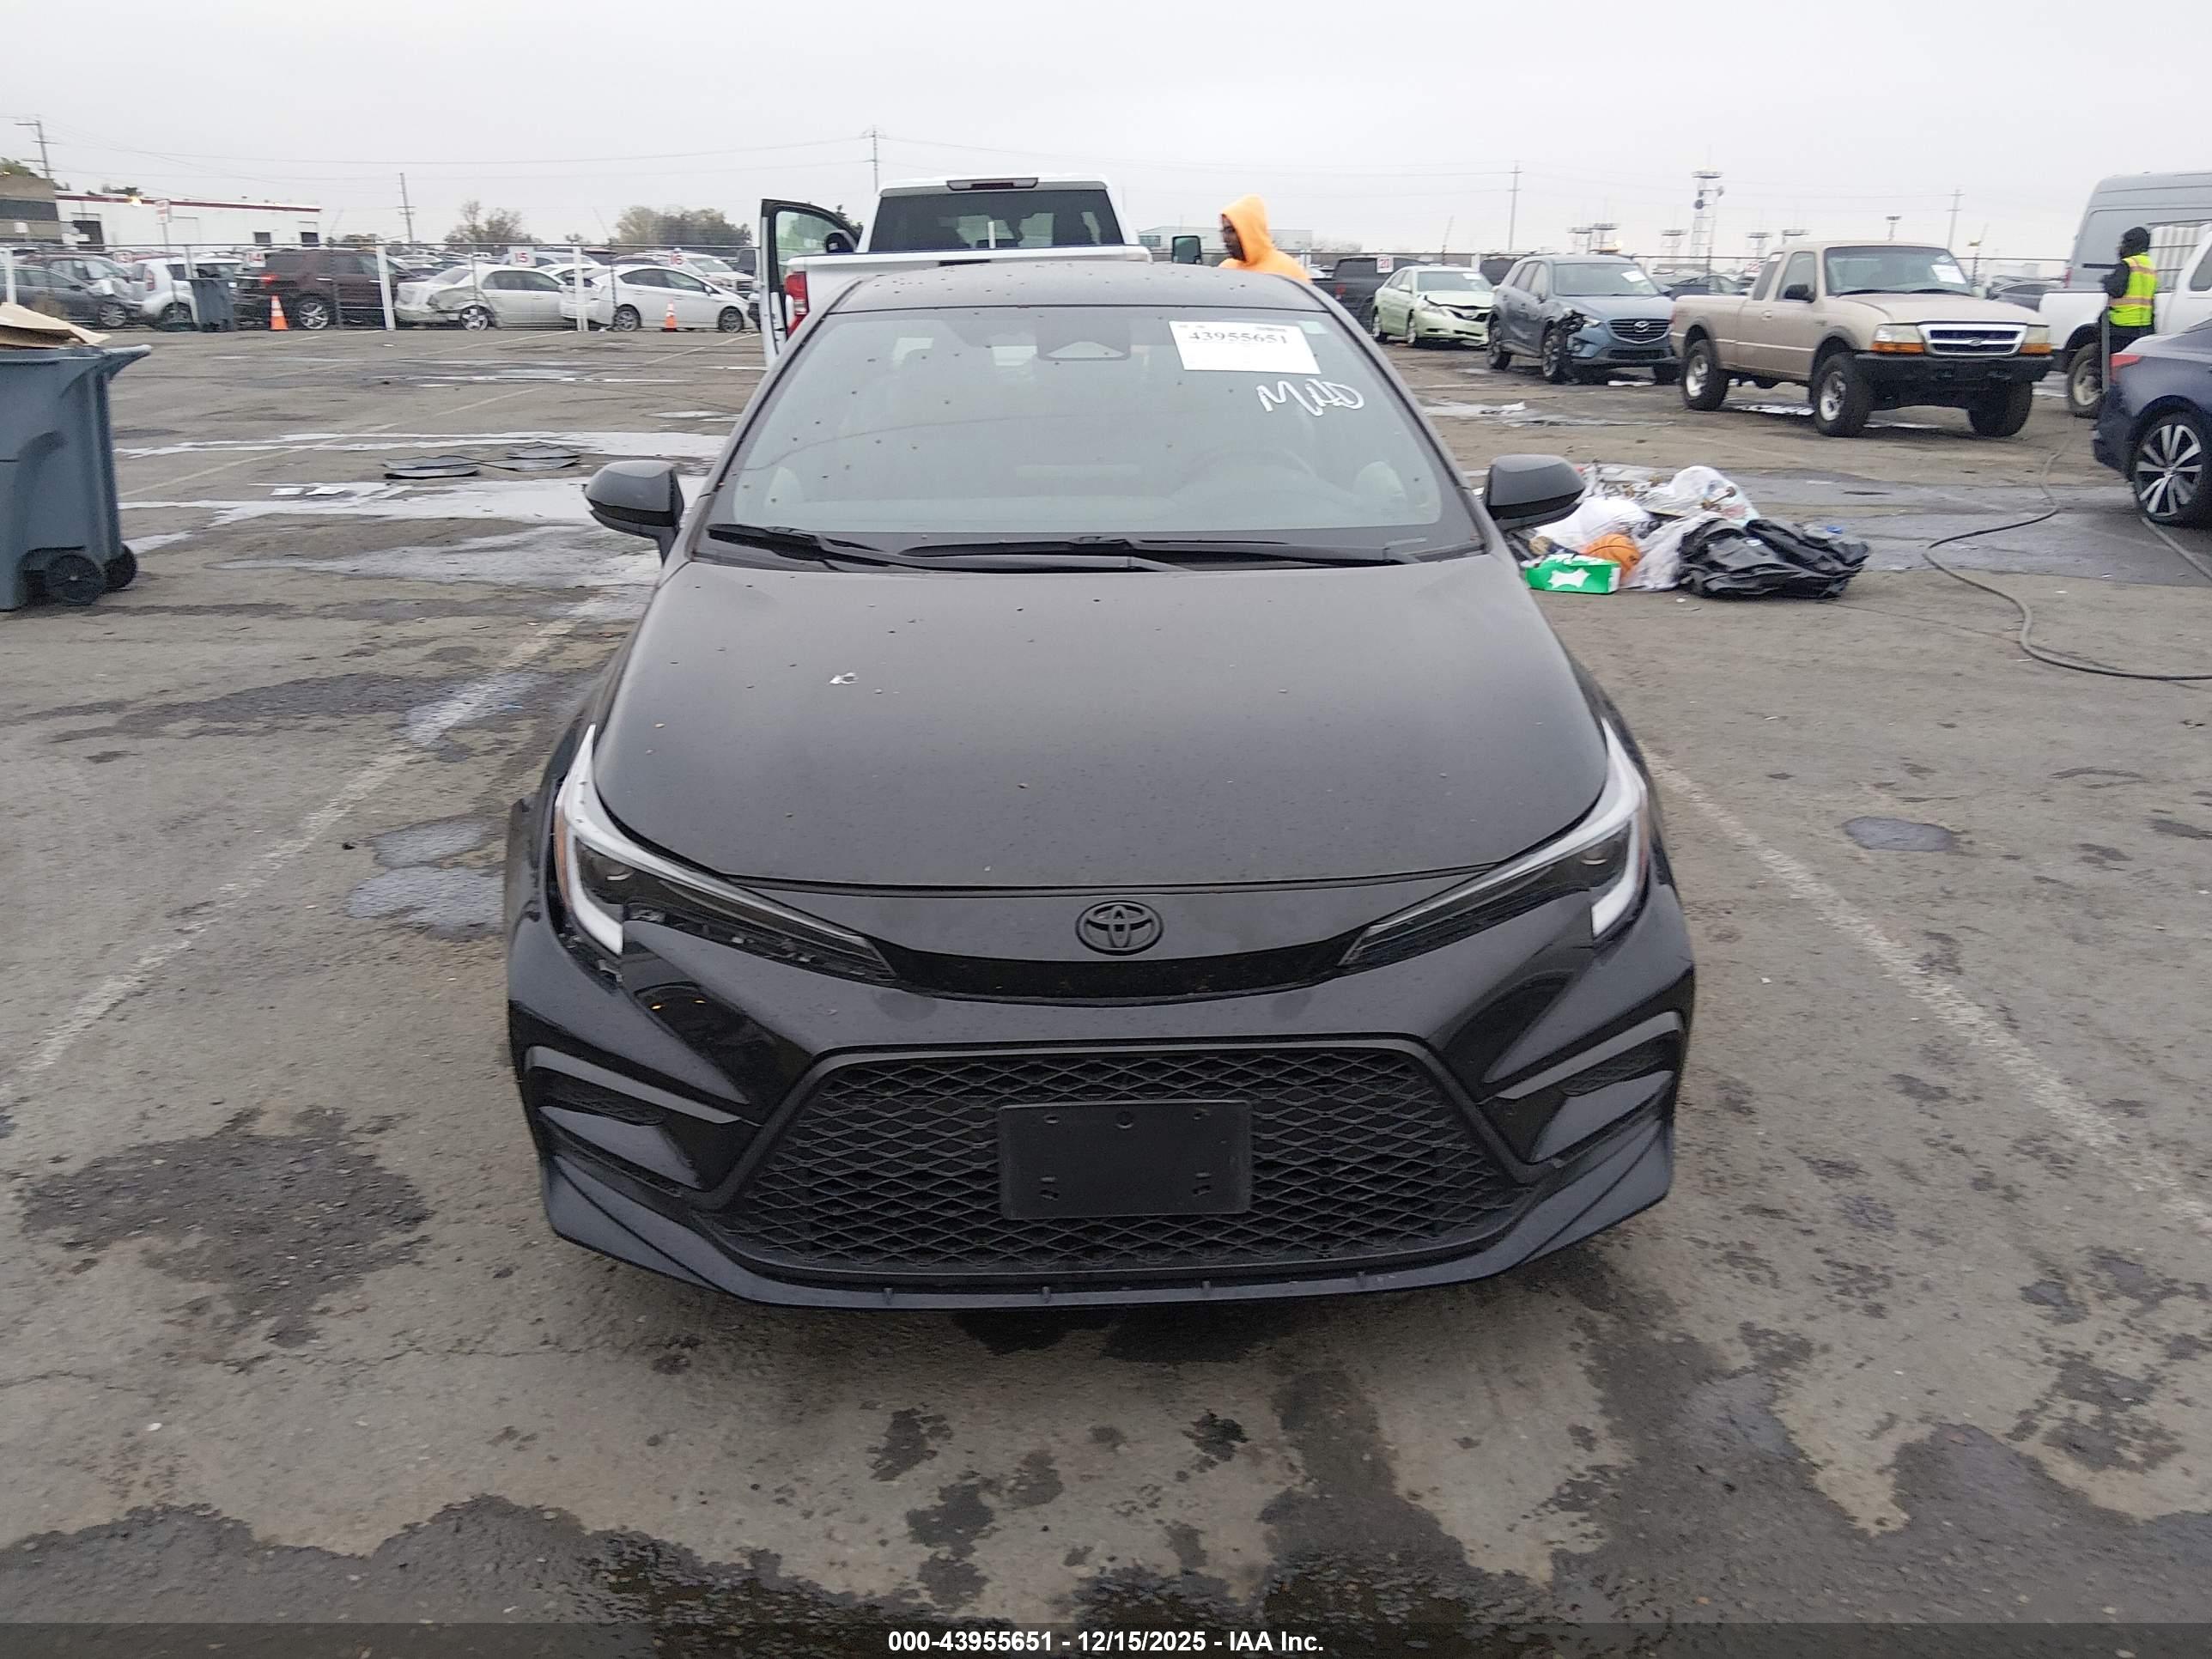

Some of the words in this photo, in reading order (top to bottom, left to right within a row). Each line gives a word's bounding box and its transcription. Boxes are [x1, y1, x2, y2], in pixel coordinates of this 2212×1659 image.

[515, 252, 528, 263] 15
[671, 254, 684, 264] 16
[1188, 331, 1287, 343] 43955651
